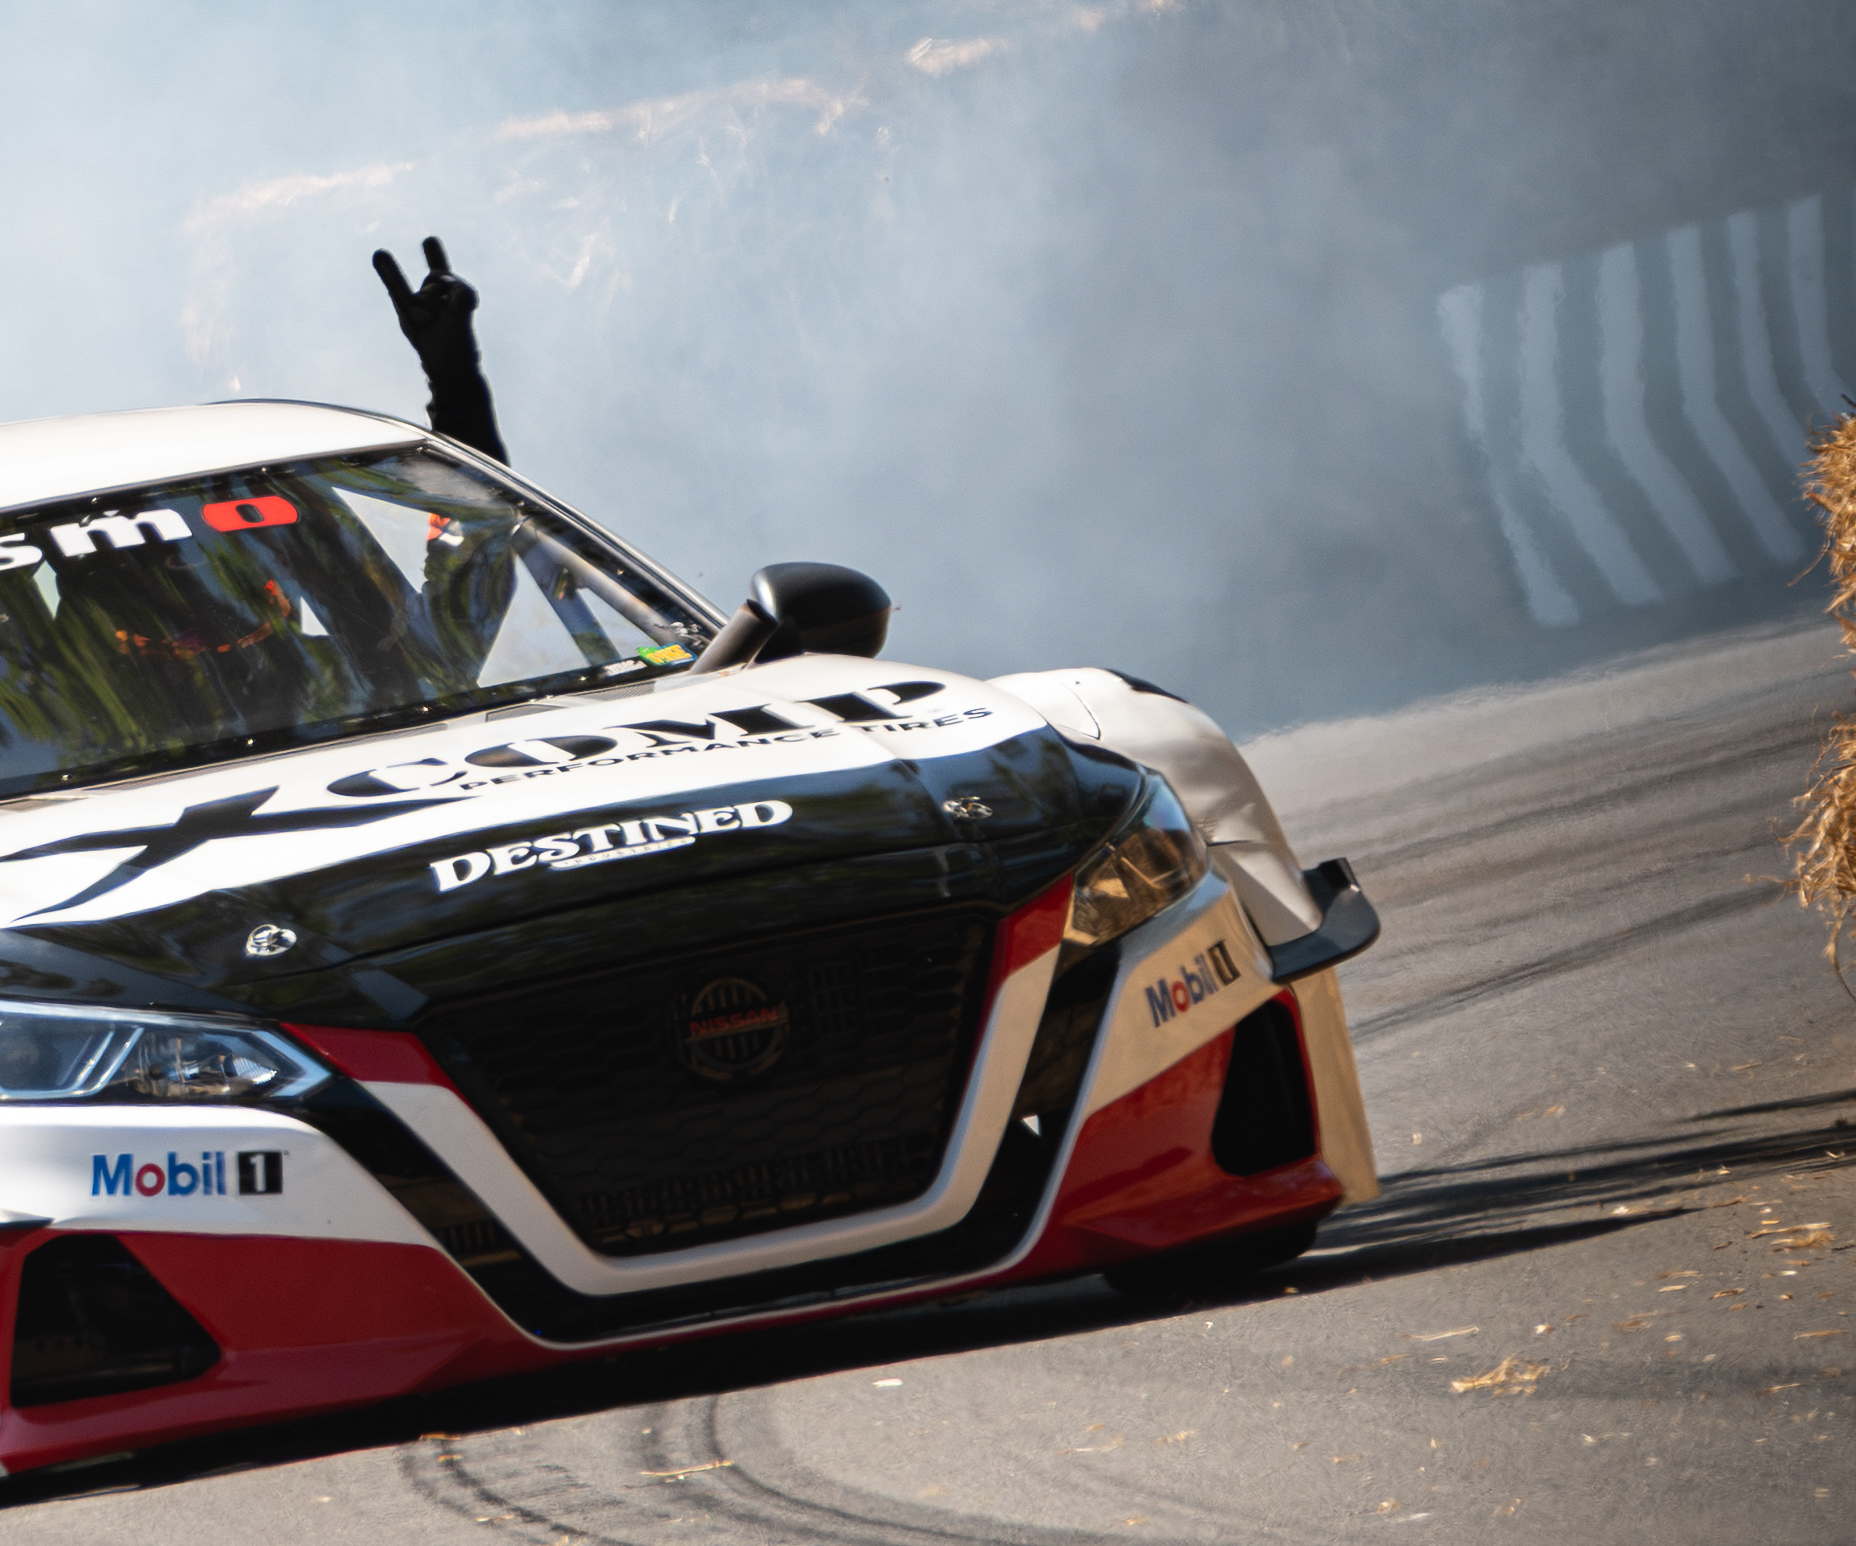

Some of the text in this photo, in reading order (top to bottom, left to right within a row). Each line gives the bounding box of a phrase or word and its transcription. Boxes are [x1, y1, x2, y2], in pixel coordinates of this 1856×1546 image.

[459, 706, 993, 791] PERFORMANCE TIRES
[429, 800, 794, 892] DESTINED
[689, 1006, 778, 1038] NISSAN
[1145, 953, 1220, 1028] Mobil
[91, 1151, 270, 1197] Mobil 1
